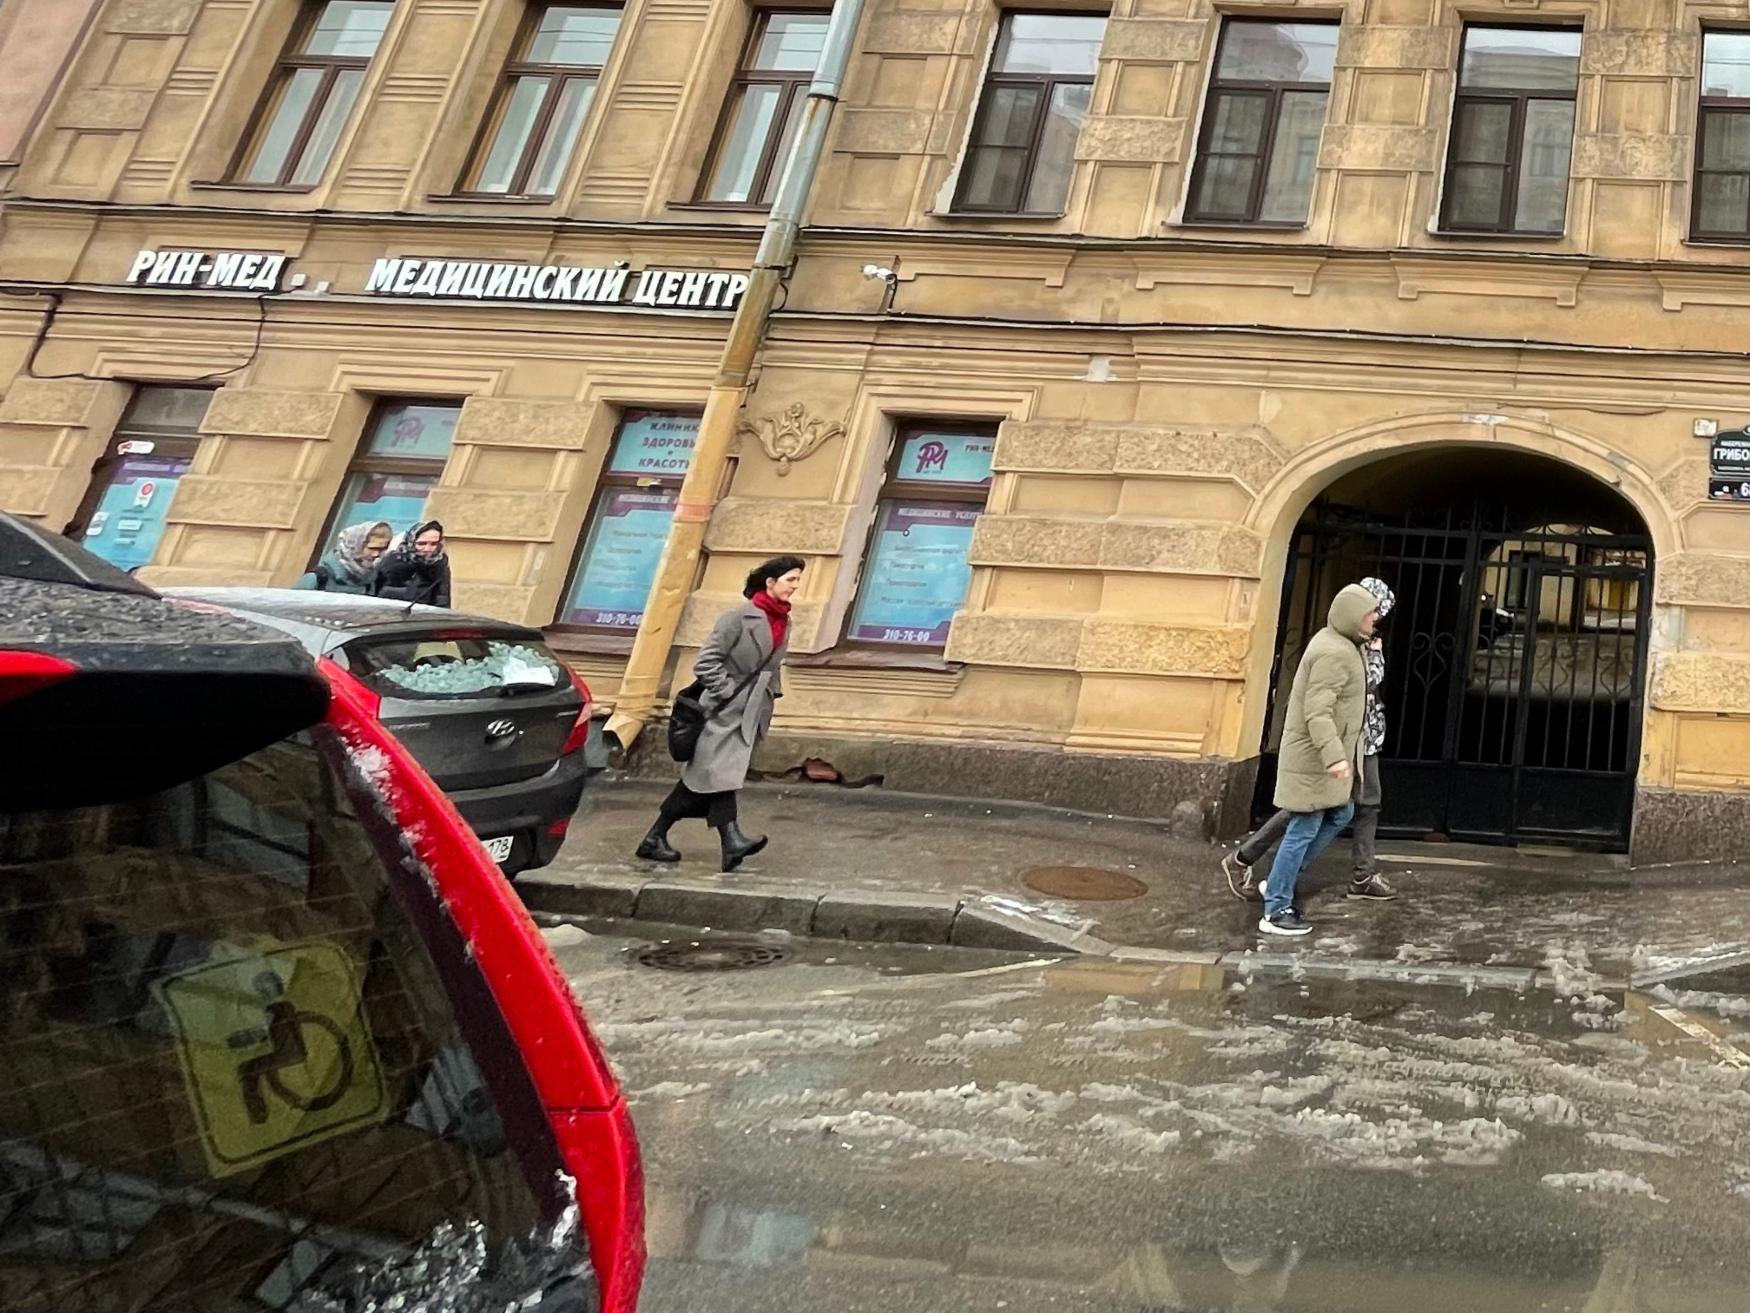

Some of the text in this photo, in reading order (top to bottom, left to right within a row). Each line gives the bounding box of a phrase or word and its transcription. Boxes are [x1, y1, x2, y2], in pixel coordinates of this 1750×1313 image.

[126, 250, 285, 291] РИН-МЕД
[365, 259, 750, 307] МЕДИЦИНСКИЙ ЦЕНТР
[650, 422, 700, 432] КЛИНИК
[642, 437, 696, 448] ЗДОРОВЬ
[882, 629, 930, 643] 310-76-00
